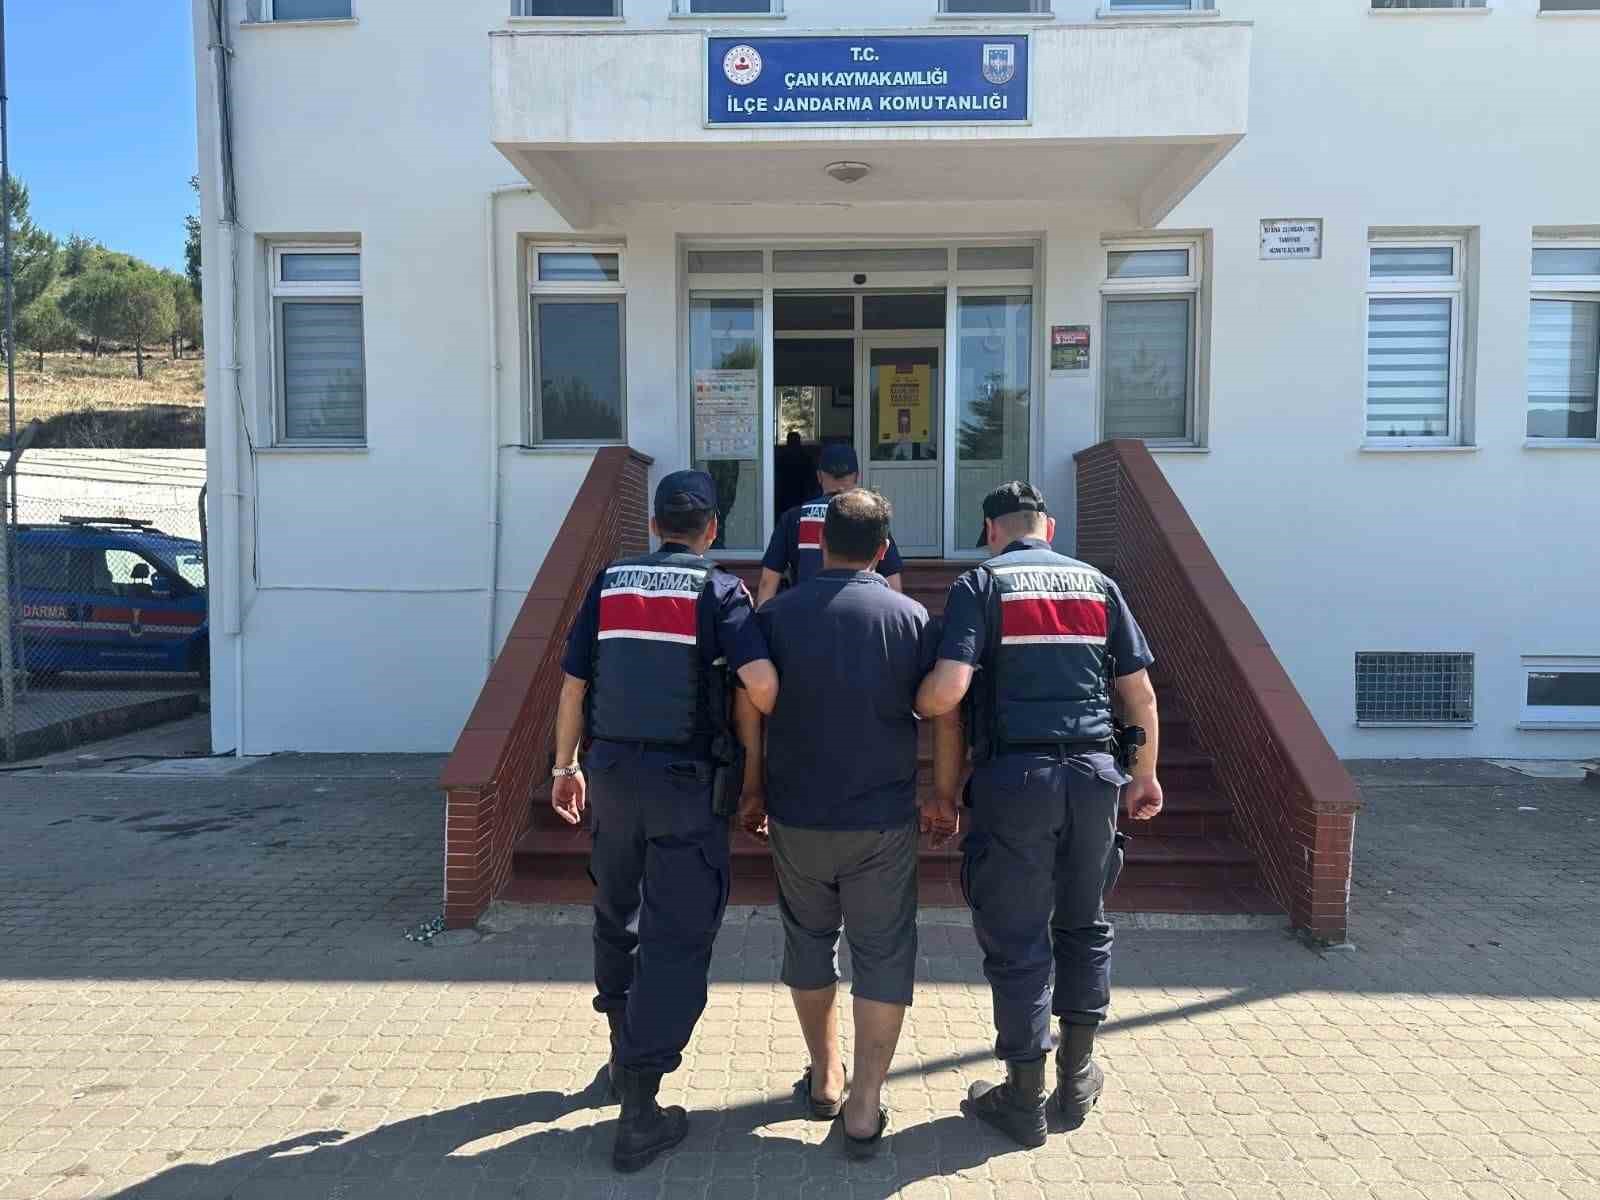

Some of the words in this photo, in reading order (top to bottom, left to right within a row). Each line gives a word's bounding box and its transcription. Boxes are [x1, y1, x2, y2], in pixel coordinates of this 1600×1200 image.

[850, 47, 879, 61] T.C.
[784, 72, 818, 89] ÇAN
[821, 67, 948, 86] KAYMAKAMLIĞI
[727, 95, 768, 114] İLÇE
[773, 96, 873, 112] JANDARMA
[879, 92, 1008, 111] KOMUTANLIĞI
[807, 505, 826, 518] JAN
[610, 570, 692, 591] JANDARMA
[1010, 572, 1098, 592] JANDARMA
[23, 604, 66, 618] DARMA
